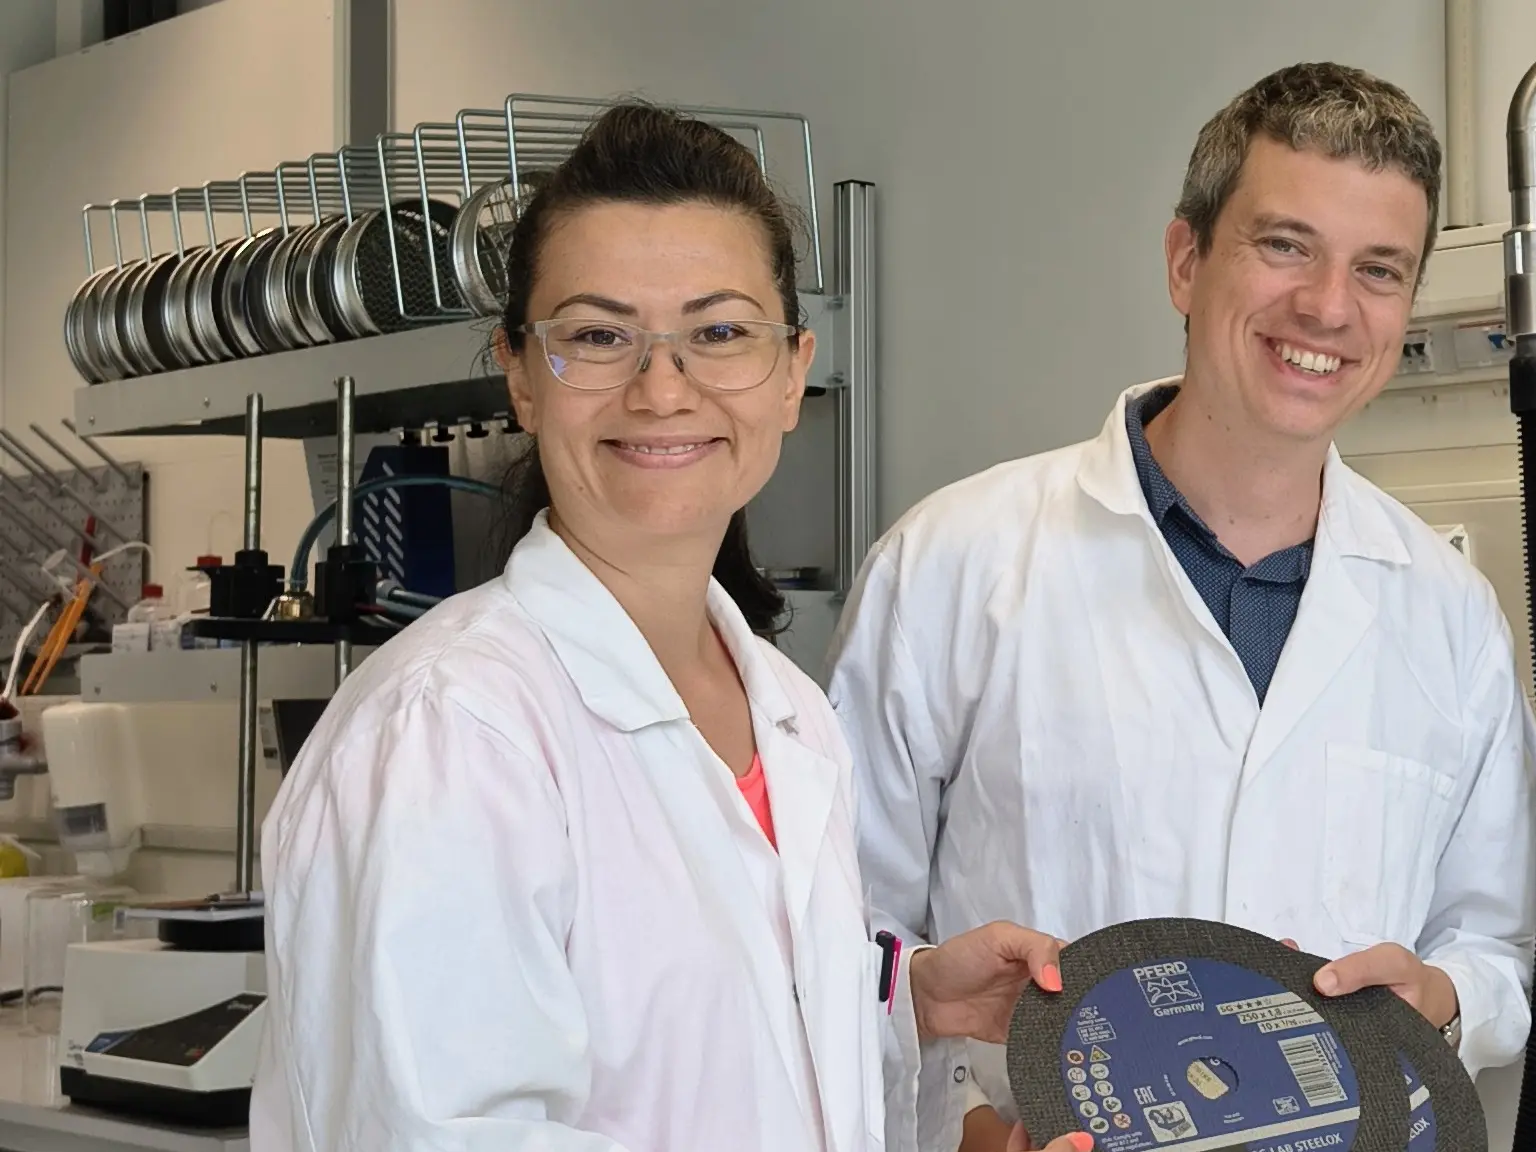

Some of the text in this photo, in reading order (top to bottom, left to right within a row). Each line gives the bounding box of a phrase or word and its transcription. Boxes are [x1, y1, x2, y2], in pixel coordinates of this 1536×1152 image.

[1133, 961, 1188, 980] PFERD
[1153, 1001, 1205, 1017] Germany
[1294, 1132, 1344, 1152] STEELOX
